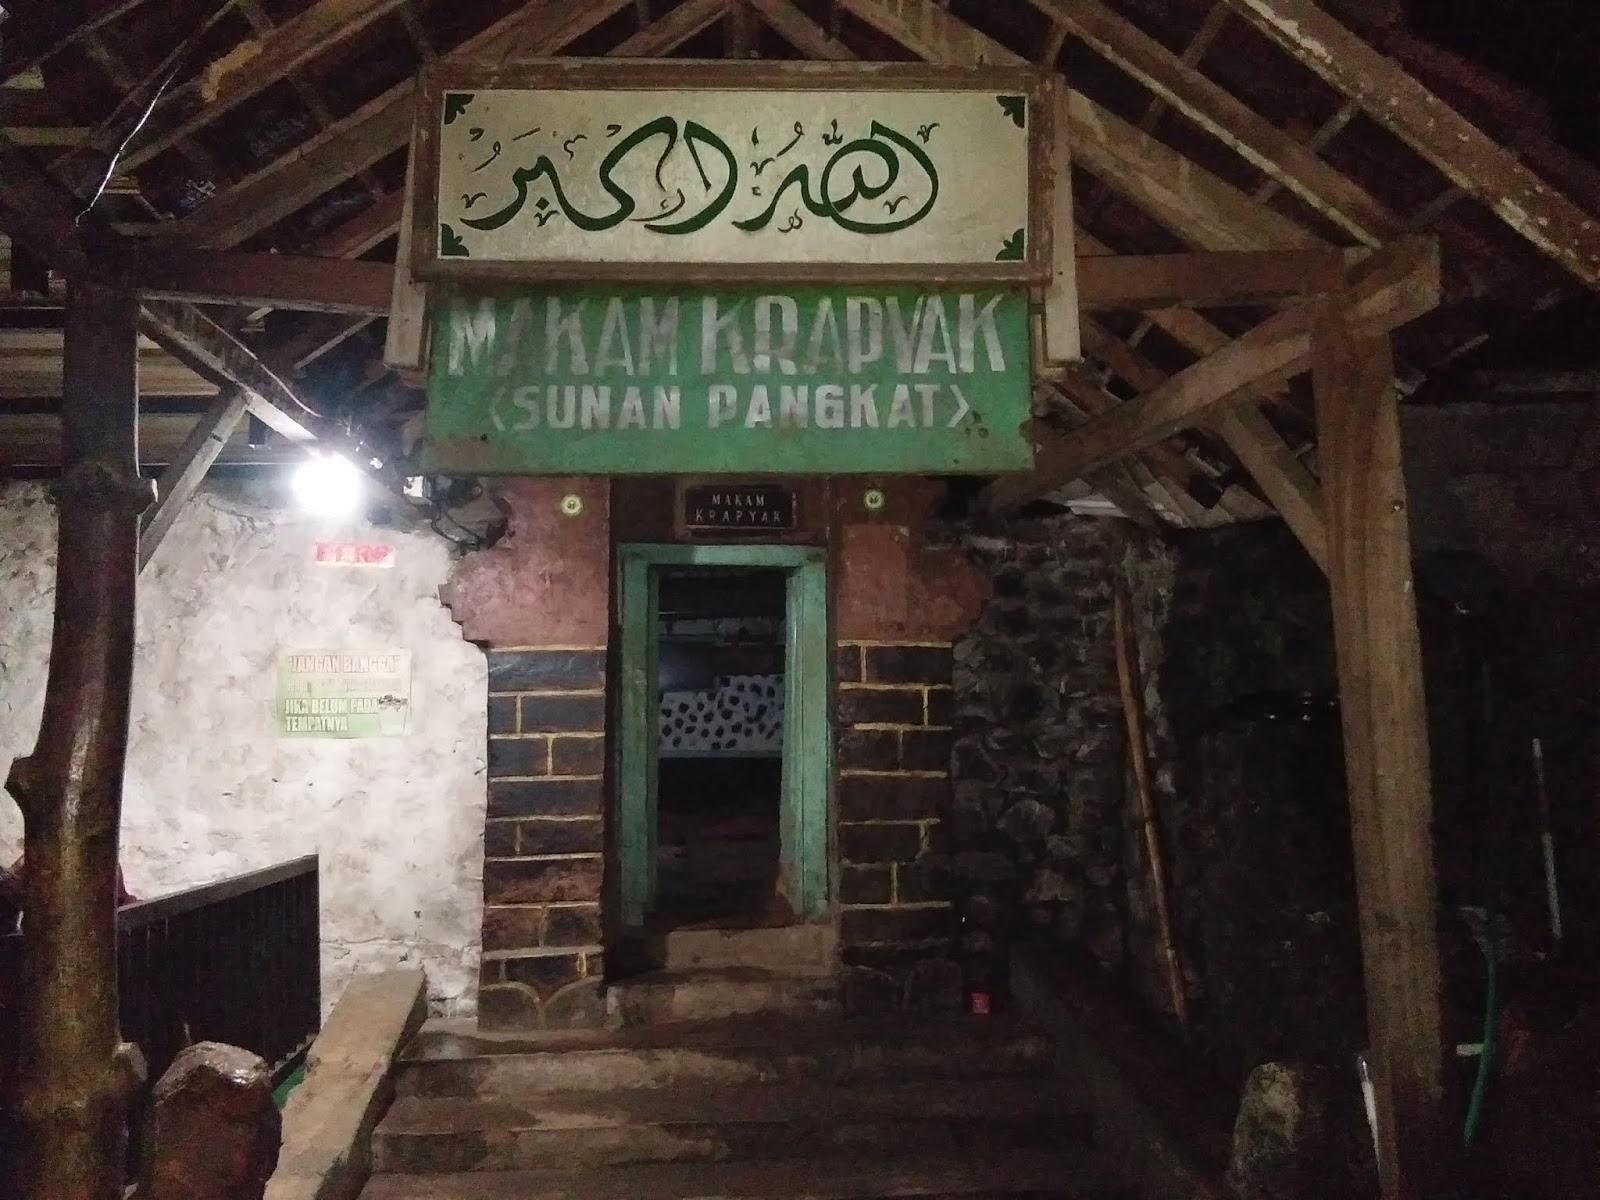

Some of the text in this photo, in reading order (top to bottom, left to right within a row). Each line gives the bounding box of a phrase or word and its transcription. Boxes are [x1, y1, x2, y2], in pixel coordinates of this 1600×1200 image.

[448, 293, 1006, 376] MAKAM KRAPYAK
[711, 493, 765, 507] MAKAM
[695, 507, 782, 523] KRAPYAK
[284, 698, 309, 714] JIKA
[310, 698, 348, 714] BELUM
[285, 715, 349, 732] TEMPATNYA
